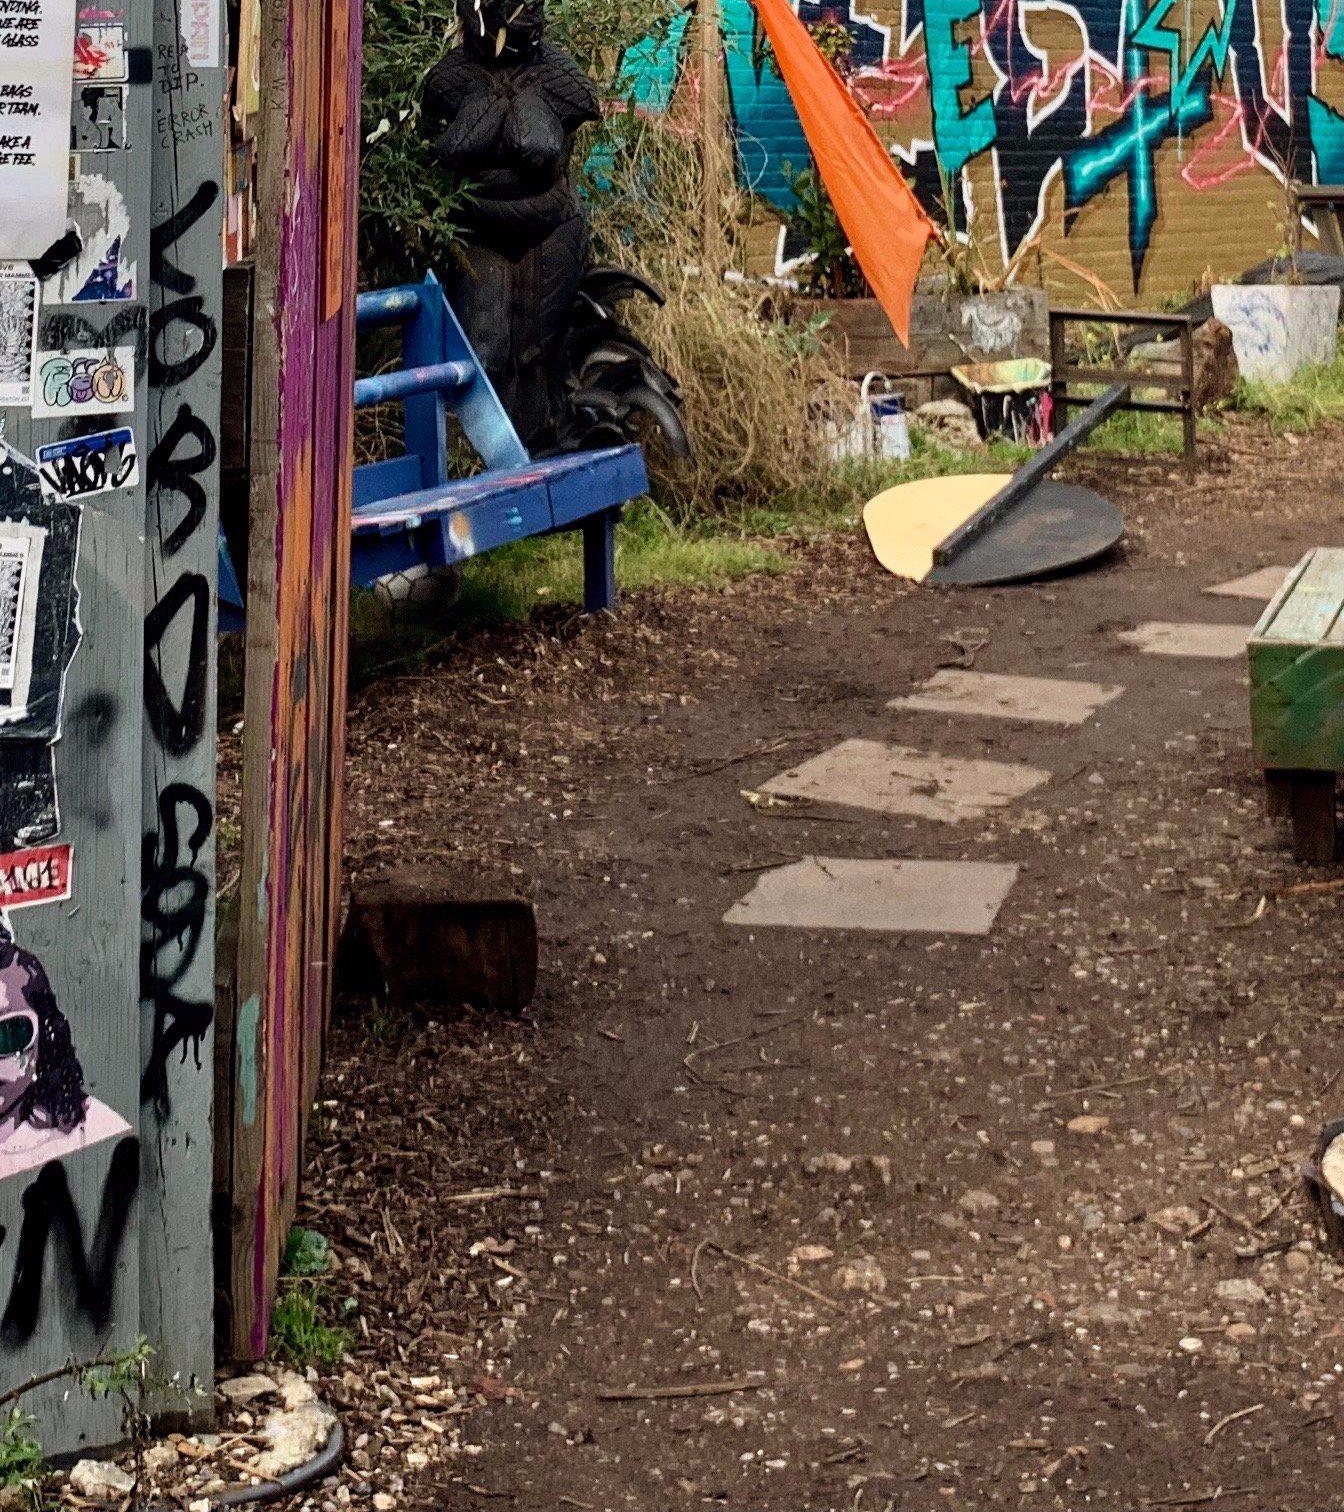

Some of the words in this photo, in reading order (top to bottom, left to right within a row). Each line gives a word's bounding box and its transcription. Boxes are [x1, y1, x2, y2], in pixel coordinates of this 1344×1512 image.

[15, 18, 42, 30] ARE
[2, 34, 39, 47] GLASS
[0, 84, 33, 99] BAGS
[22, 136, 31, 148] A
